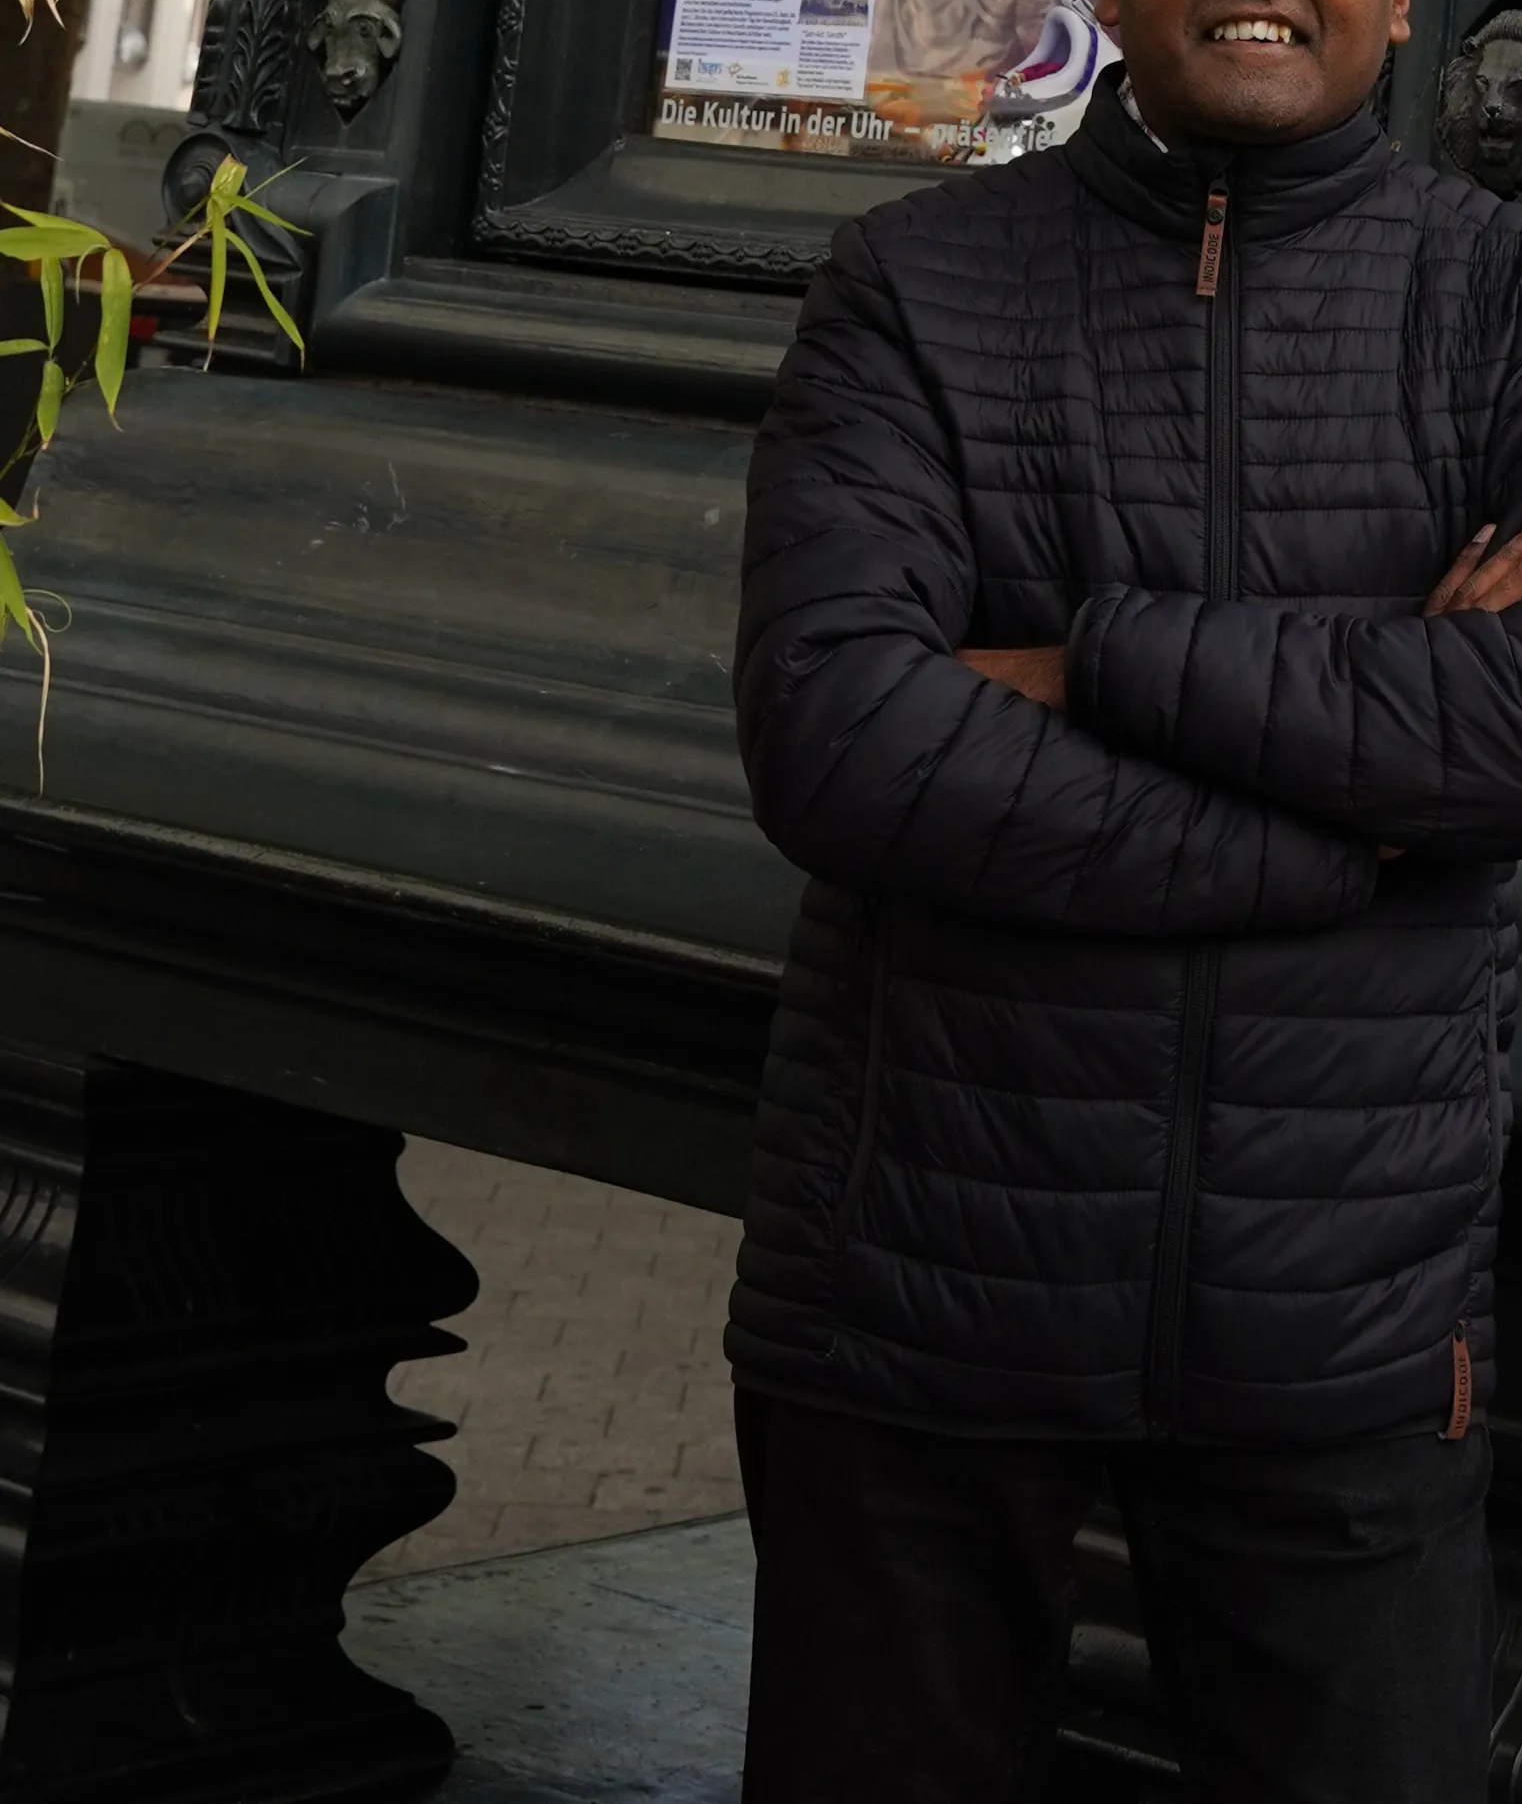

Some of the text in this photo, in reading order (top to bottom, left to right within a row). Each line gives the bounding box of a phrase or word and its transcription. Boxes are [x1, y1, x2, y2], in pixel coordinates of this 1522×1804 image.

[661, 98, 697, 125] Die
[702, 100, 775, 133] Kultur
[780, 105, 801, 134] in
[807, 107, 846, 137] der
[851, 110, 894, 141] Uhr
[1203, 233, 1219, 283] INDICODE
[1456, 1356, 1468, 1429] INDICODE
